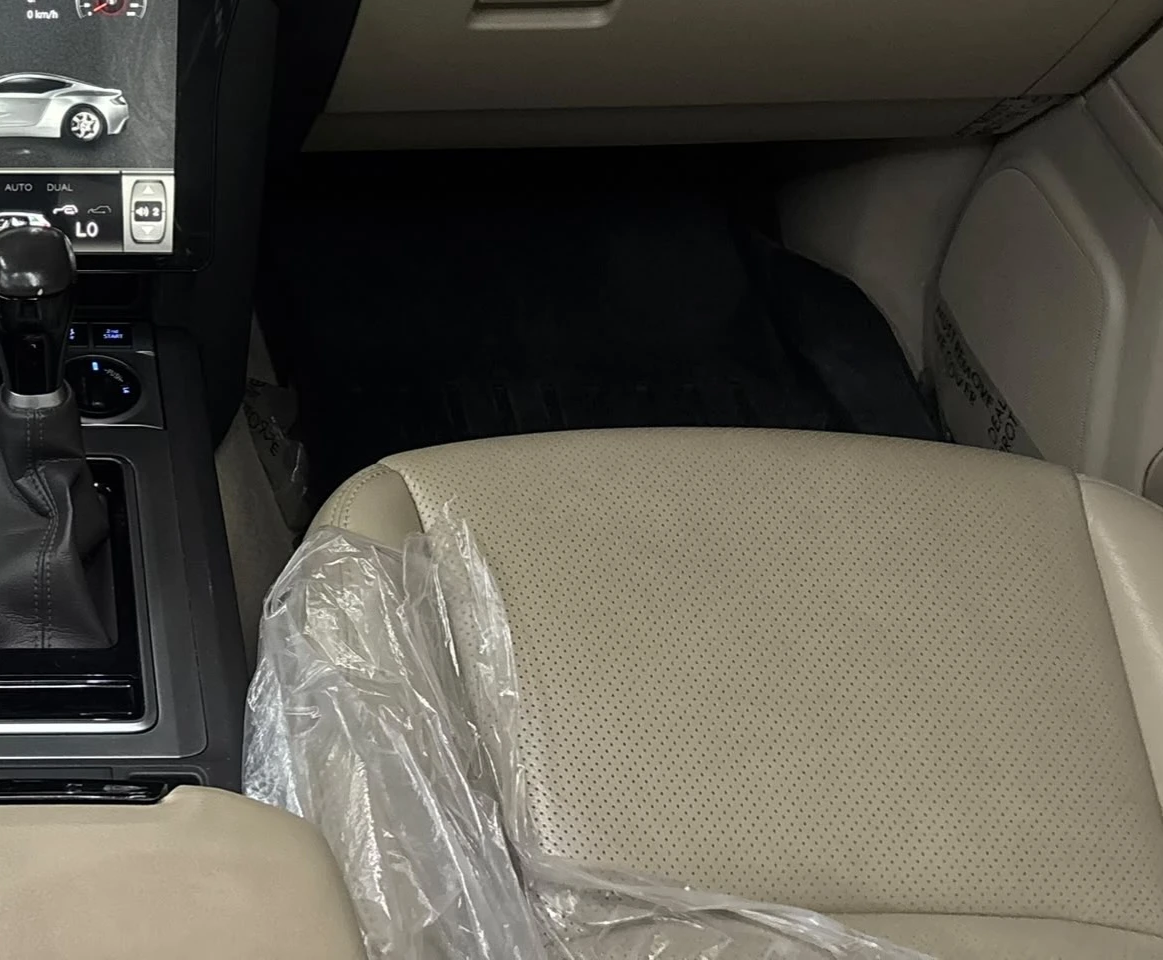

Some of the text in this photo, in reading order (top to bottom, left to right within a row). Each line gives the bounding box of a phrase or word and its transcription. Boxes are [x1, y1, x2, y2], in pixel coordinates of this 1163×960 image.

[27, 9, 59, 19] 0 km/h
[4, 182, 33, 192] AUTO
[46, 182, 73, 192] DUAL
[152, 208, 160, 217] 2
[75, 222, 99, 238] LO
